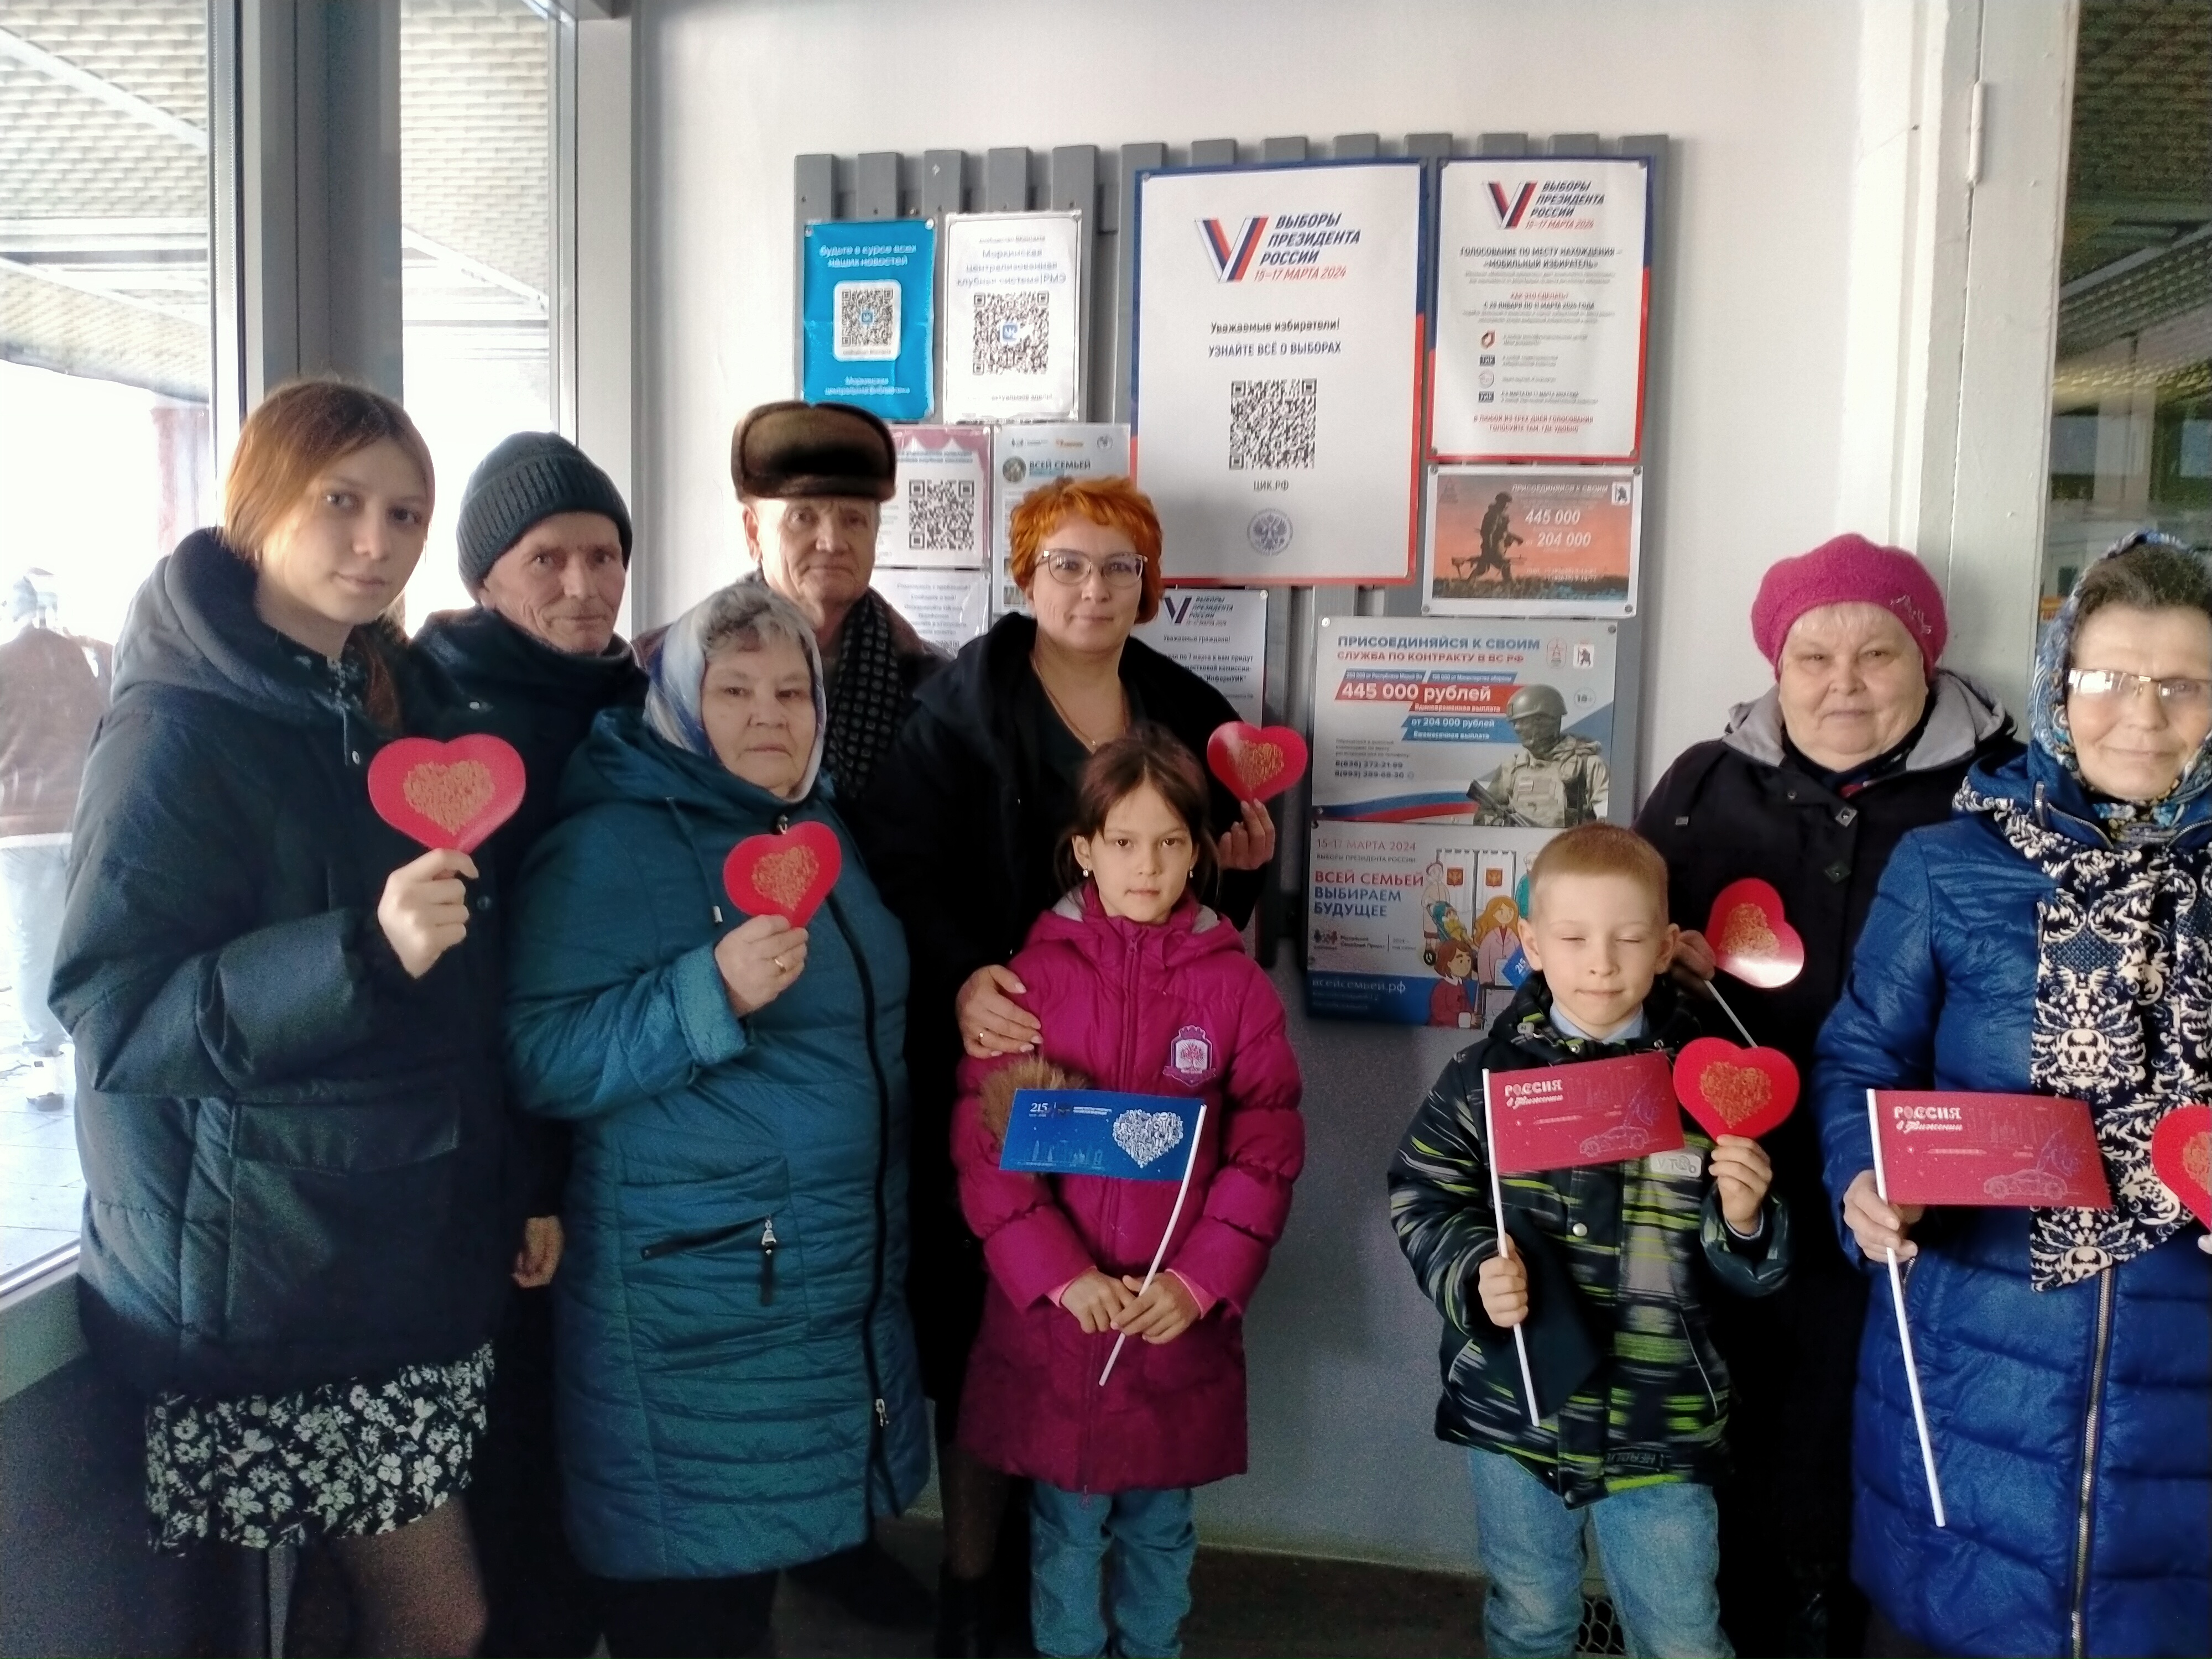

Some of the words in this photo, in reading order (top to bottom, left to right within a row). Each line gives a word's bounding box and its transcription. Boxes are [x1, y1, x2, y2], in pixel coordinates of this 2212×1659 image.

[1541, 180, 1592, 192] ВЫБОРЫ
[1535, 194, 1605, 206] ПРЕЗИДЕНТА
[1529, 207, 1576, 218] РОССИИ
[1274, 212, 1343, 230] ВЫБОРЫ
[1267, 229, 1361, 248] ПРЕЗИДЕНТА
[1259, 249, 1321, 267] РОССИИ
[1460, 246, 1516, 257] ГОЛОСОВАНИЕ
[1560, 246, 1615, 257] НАХОЖДЕНИЯ
[1283, 267, 1319, 281] МАРТА
[1320, 266, 1347, 279] 2024
[1210, 321, 1272, 335] Уважаемые
[1274, 317, 1340, 332] избиратели!
[1208, 341, 1255, 358] УЗНАЙТЕ
[1258, 340, 1277, 356] ВСЁ
[1280, 342, 1288, 355] О
[1290, 340, 1342, 355] ВЫБОРАХ
[1029, 458, 1052, 469] ВСЕЙ
[1054, 458, 1091, 470] СЕМЬЕЙ
[1253, 479, 1290, 492] ЦИК.РФ
[1554, 508, 1581, 525] 000
[1537, 531, 1563, 547] 204
[1566, 531, 1592, 548] 000
[1338, 635, 1469, 650] ПРИСОЕДИНЯЙСЯ
[1472, 638, 1482, 649] К
[1485, 638, 1541, 650] СВОИМ
[1231, 655, 1254, 663] придут
[1337, 650, 1386, 661] СЛУЖБА
[1388, 651, 1405, 661] ПО
[1407, 652, 1475, 662] КОНТРАКТУ
[1477, 653, 1485, 662] В
[1488, 653, 1504, 663] ВС
[1342, 682, 1377, 699] 445
[1382, 682, 1419, 700] 000
[1423, 685, 1491, 705] рублей
[1422, 717, 1441, 727] 204
[1442, 717, 1460, 727] 000
[1462, 718, 1495, 730] рублей
[1347, 839, 1386, 851] МАРТА
[1390, 841, 1416, 852] 2024
[1345, 854, 1387, 863] ПРЕЗИДЕНТА
[1315, 869, 1355, 884] ВСЕЙ
[1360, 870, 1423, 887] СЕМЬЕЙ
[1314, 886, 1402, 902] ВЫБИРАЕМ
[1314, 901, 1387, 919] БУДУЩЕЕ
[1504, 1079, 1563, 1098] РОССИЯ
[1030, 1102, 1049, 1113] 215
[1893, 1105, 1963, 1120] РОССИЯ
